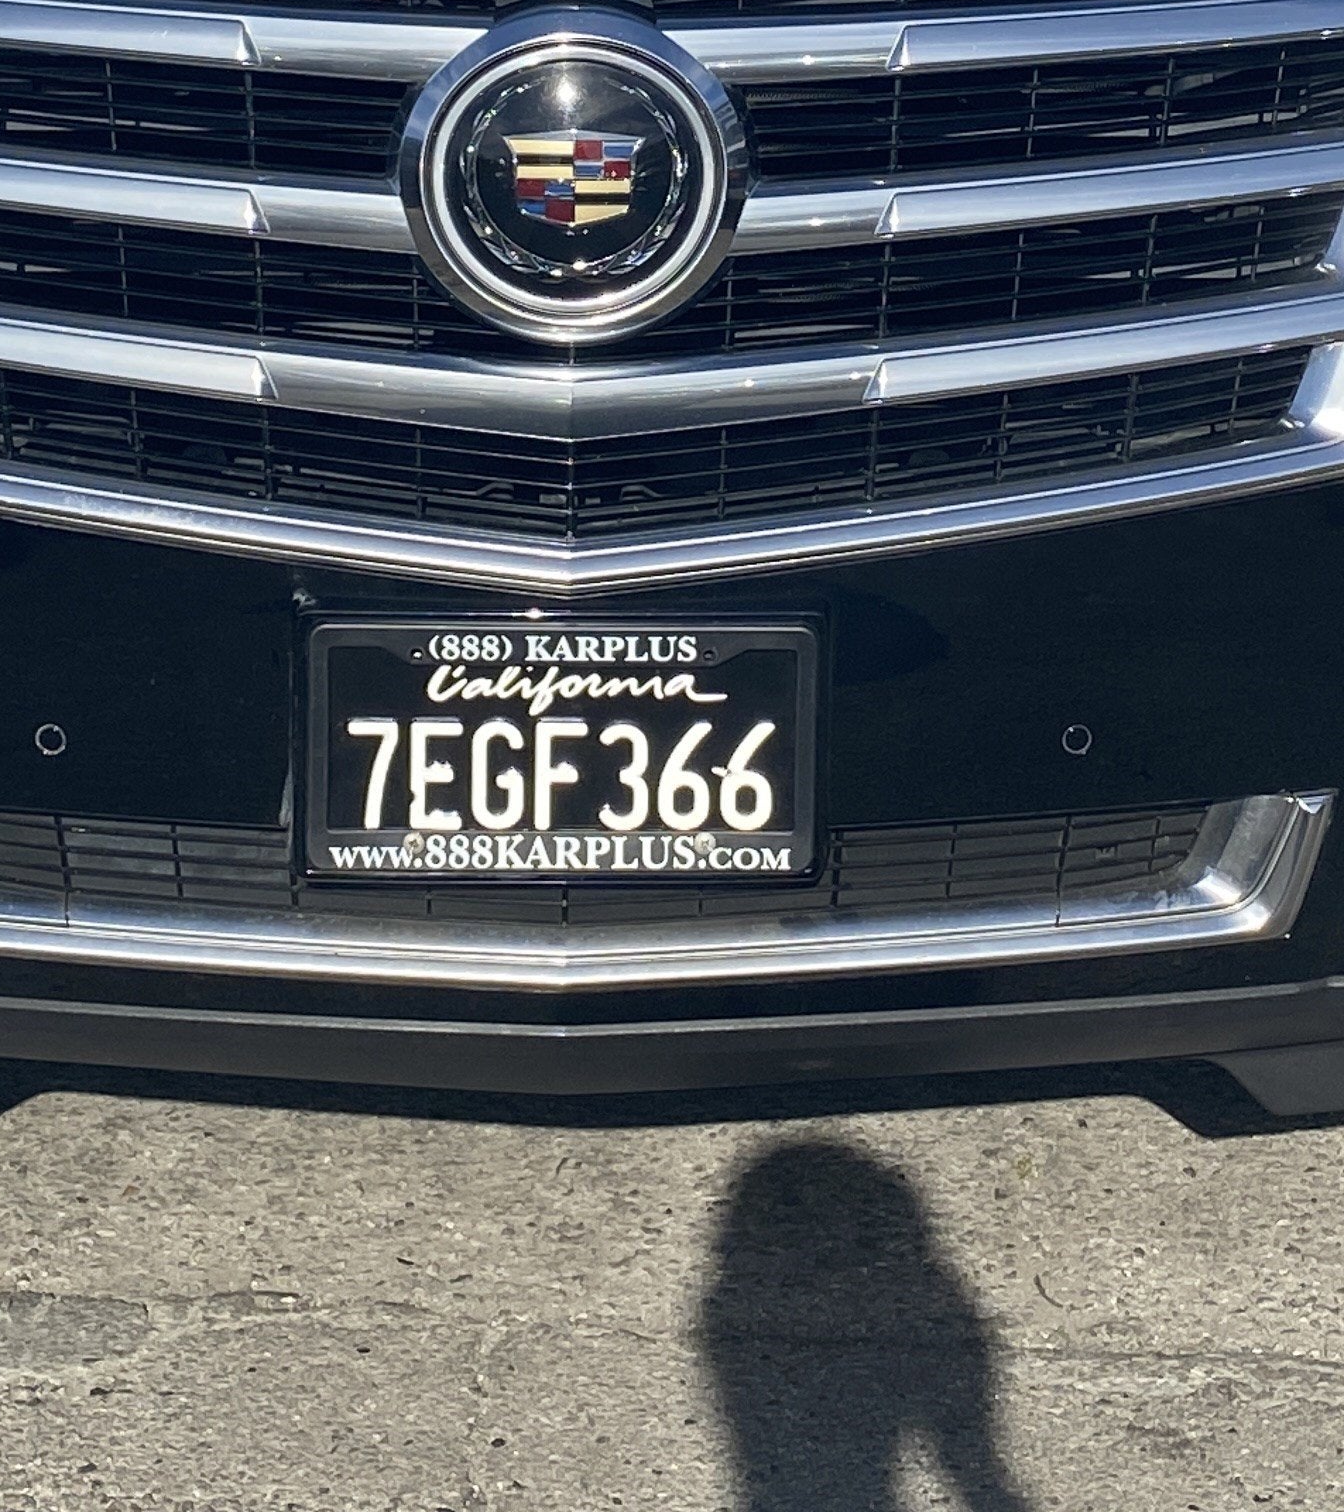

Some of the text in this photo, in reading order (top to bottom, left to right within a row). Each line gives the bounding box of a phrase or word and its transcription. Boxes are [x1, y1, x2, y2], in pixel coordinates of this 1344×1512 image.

[427, 633, 698, 663] (888) KARPLUS
[426, 664, 728, 716] California
[346, 717, 777, 831] 7EGF366
